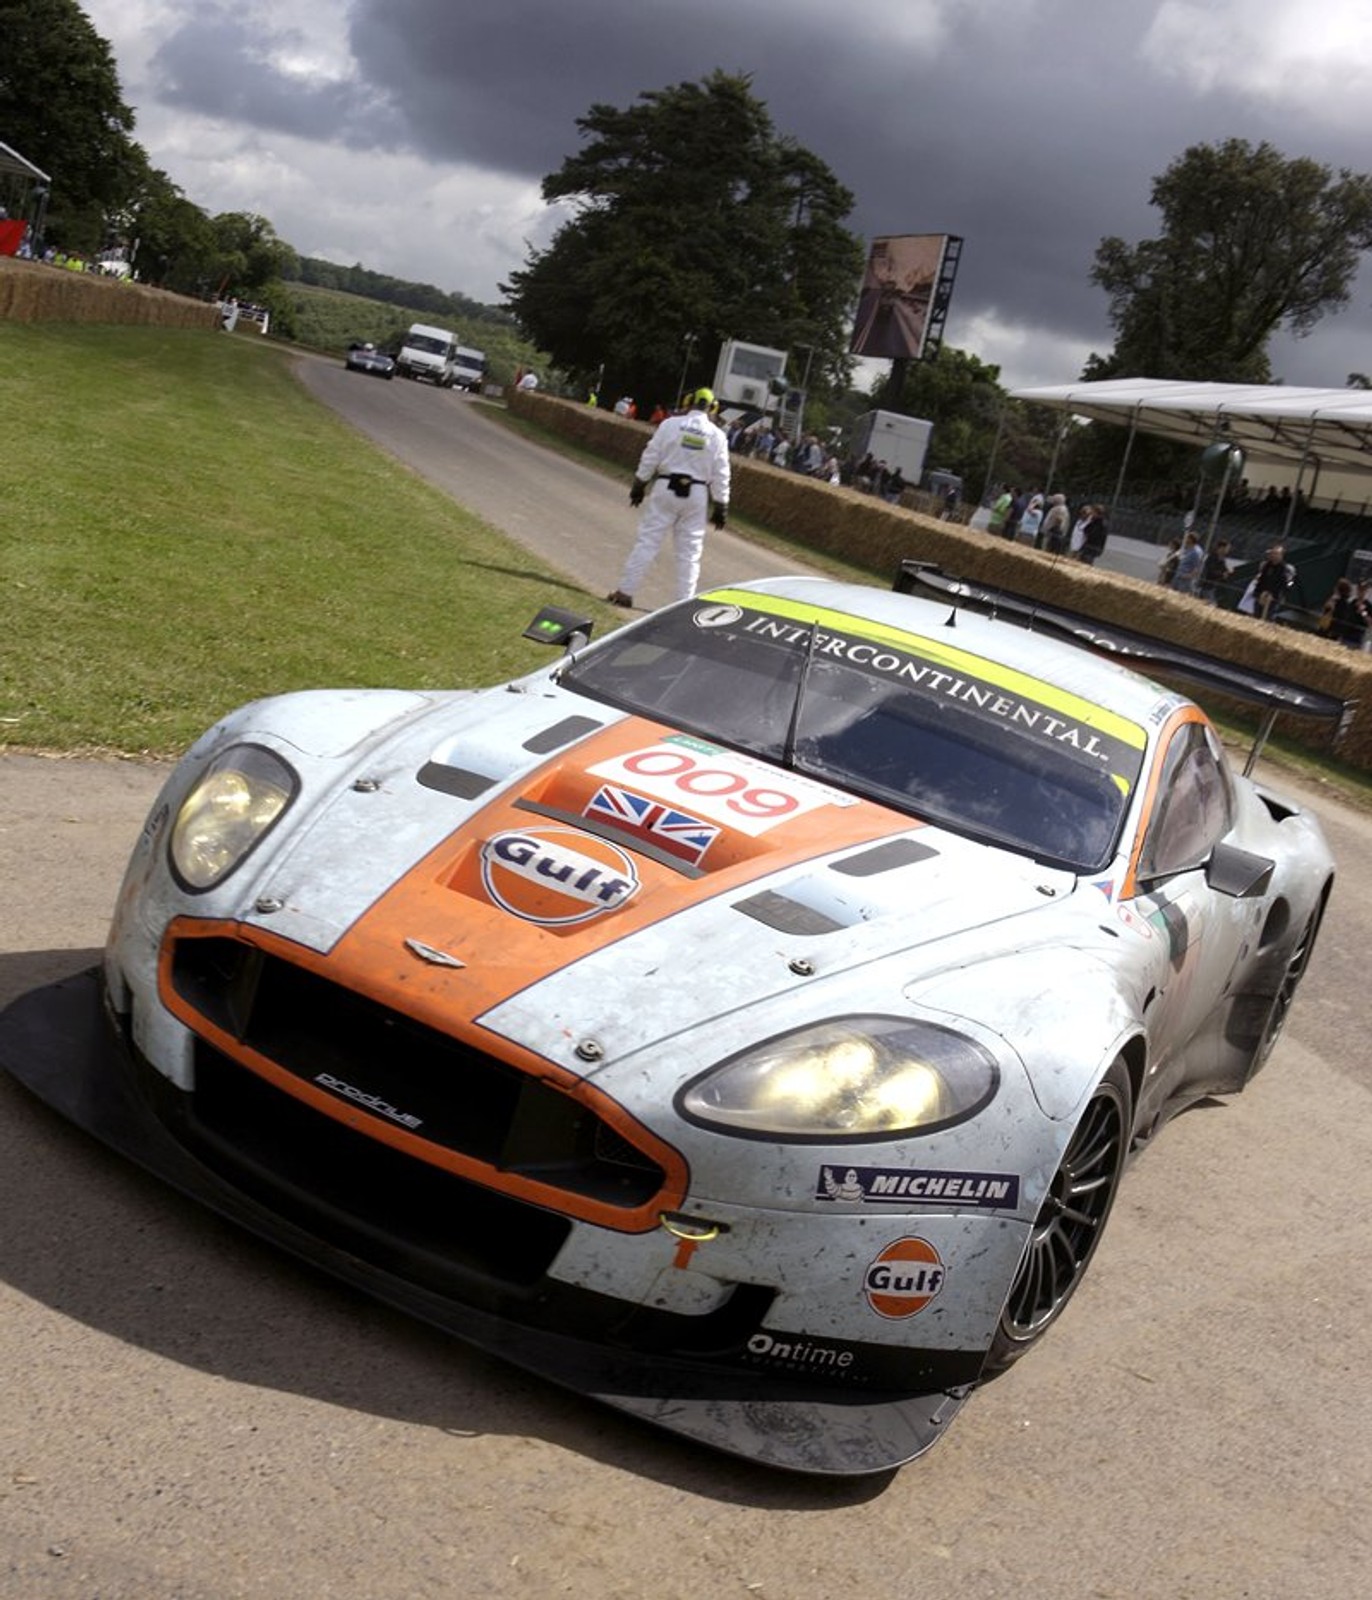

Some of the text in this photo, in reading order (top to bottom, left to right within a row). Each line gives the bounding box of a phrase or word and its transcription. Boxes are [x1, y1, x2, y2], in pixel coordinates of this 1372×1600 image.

[622, 751, 799, 818] 009
[493, 837, 631, 902] Gulf
[869, 1175, 1010, 1199] MICHELIN
[867, 1265, 943, 1292] Gulf
[747, 1333, 854, 1367] Ontime
